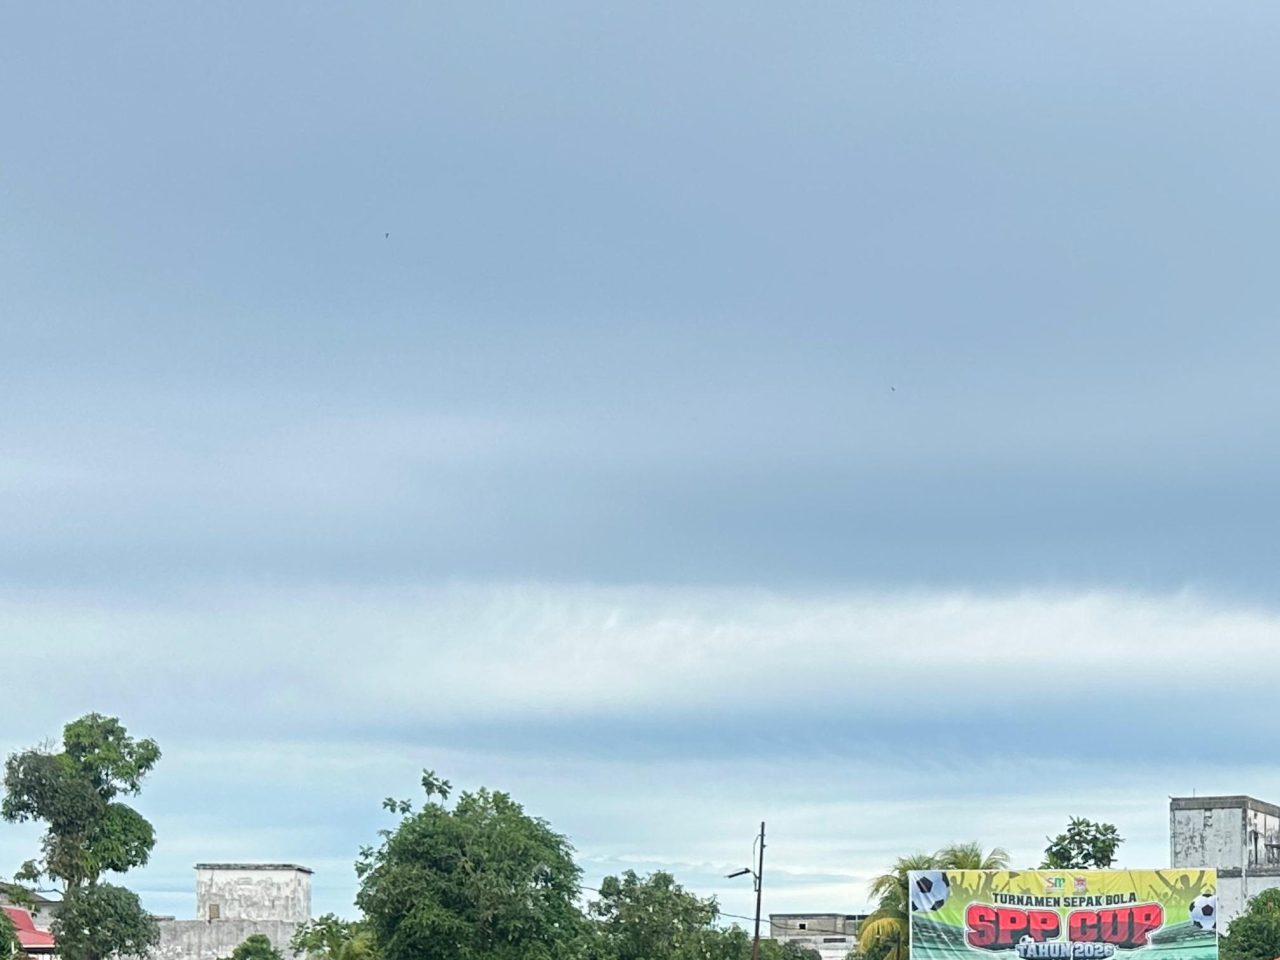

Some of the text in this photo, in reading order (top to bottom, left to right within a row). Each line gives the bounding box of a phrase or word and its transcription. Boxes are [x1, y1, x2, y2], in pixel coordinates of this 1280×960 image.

[993, 892, 1136, 907] TURNAMEN SEPAK BOLA
[967, 904, 1164, 947] SPP CUP
[1017, 943, 1114, 959] TAHUN 2026
